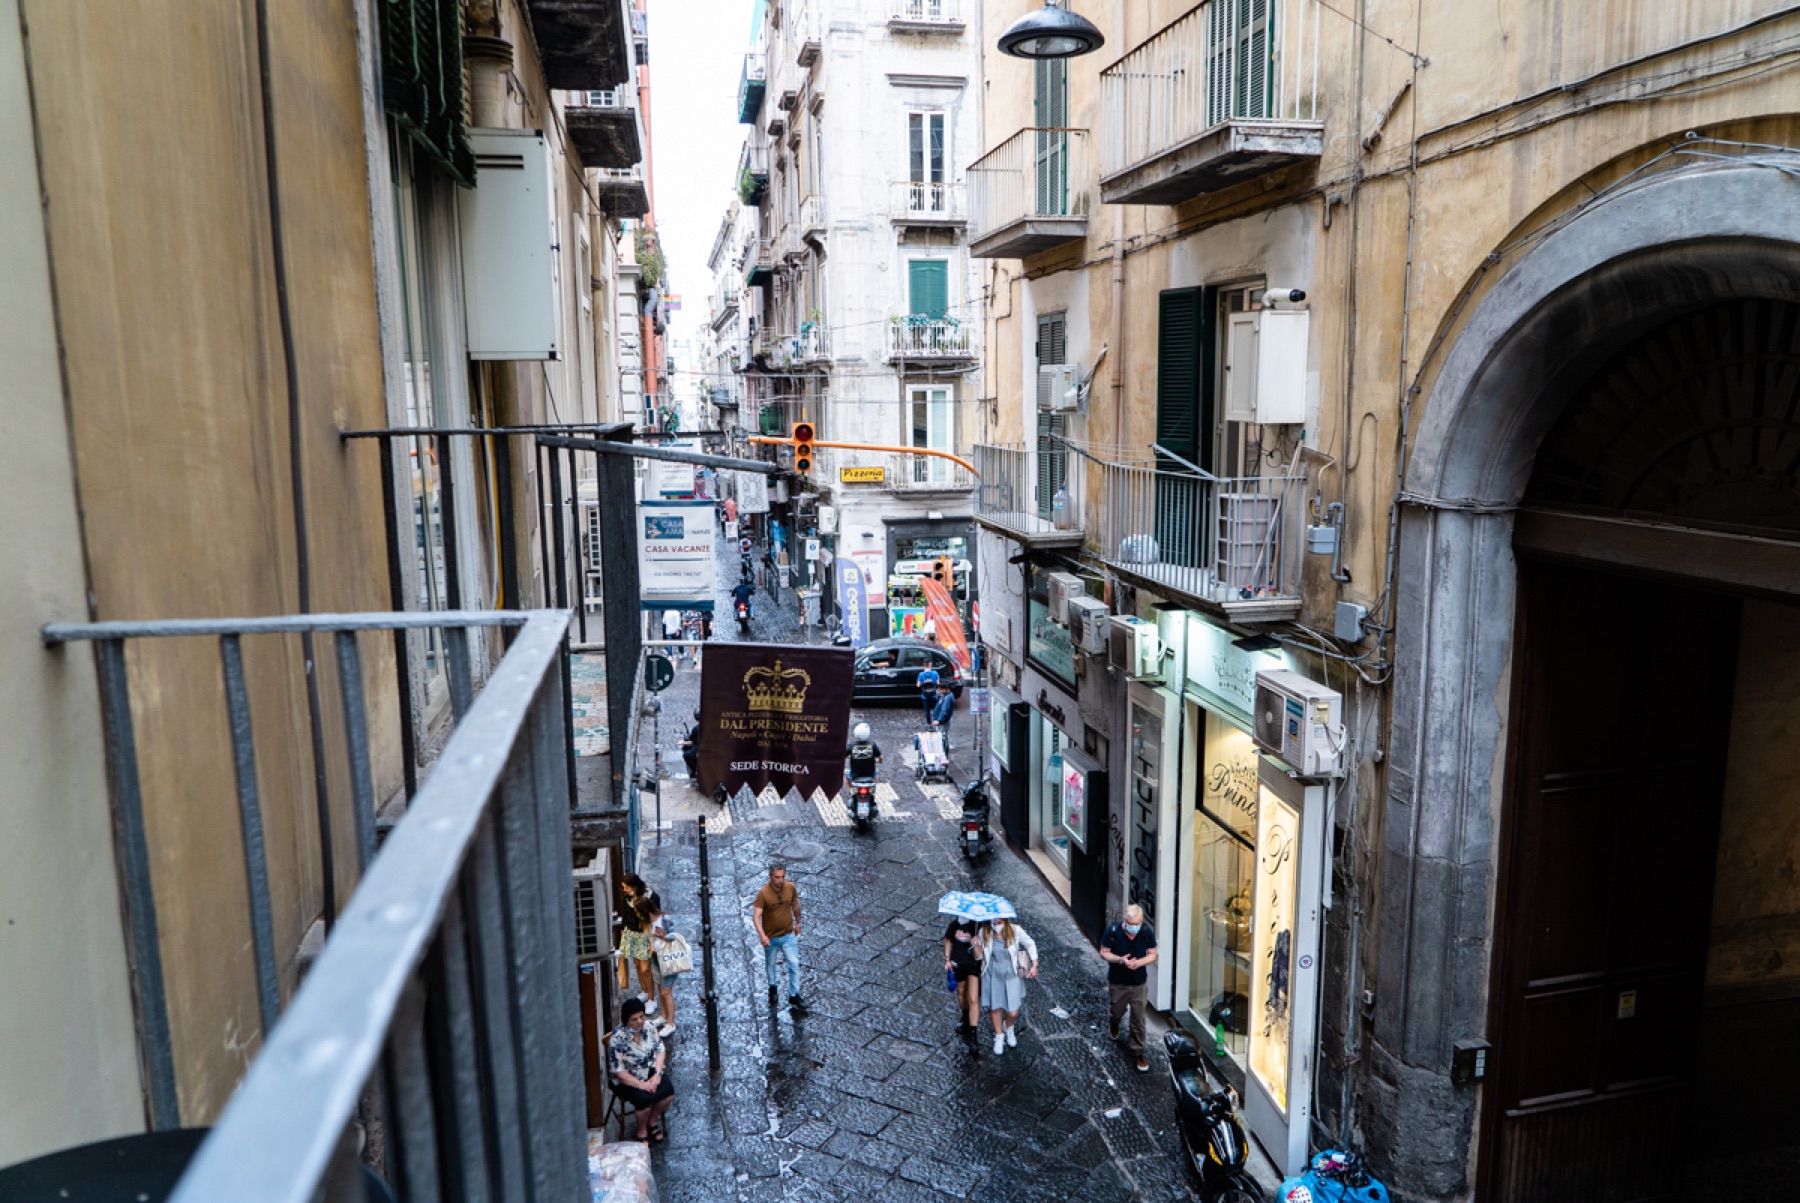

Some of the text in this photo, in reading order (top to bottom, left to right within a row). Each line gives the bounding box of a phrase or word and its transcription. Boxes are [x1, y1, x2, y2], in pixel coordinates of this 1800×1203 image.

[843, 468, 882, 478] Pizzeria
[671, 545, 711, 553] VACANZE
[720, 719, 829, 733] DAL PRESIDENTE
[730, 730, 757, 740] Napoli
[792, 733, 817, 742] Dubai
[730, 760, 810, 774] SEDE STORICA
[1135, 756, 1155, 873] TUTTO
